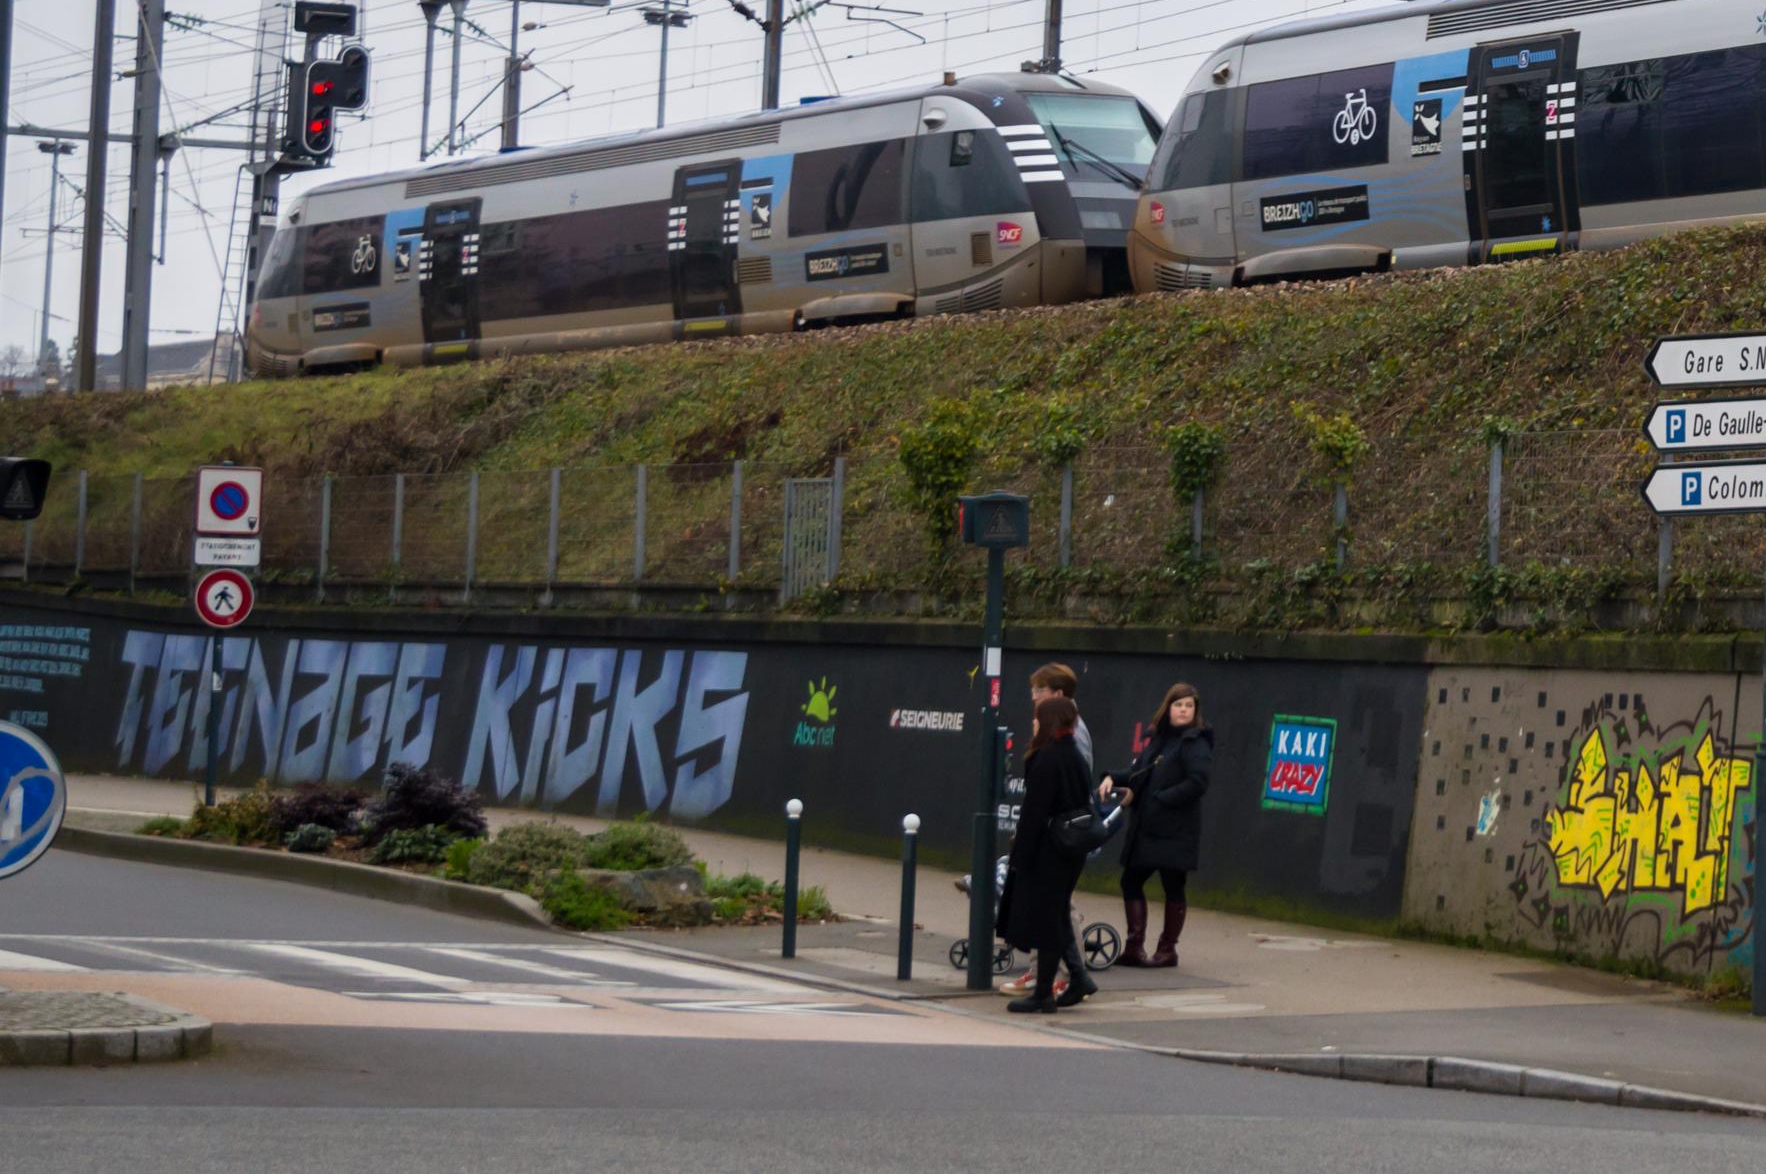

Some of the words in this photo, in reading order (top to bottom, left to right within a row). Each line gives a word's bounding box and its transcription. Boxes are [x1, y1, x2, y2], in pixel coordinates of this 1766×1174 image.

[1000, 228, 1022, 241] SNCF
[1684, 350, 1724, 374] Gare
[1693, 414, 1711, 437] De
[115, 629, 448, 785] TEENAGE
[462, 644, 750, 820] KICKS
[901, 710, 964, 730] SEIGNEURIE
[1278, 730, 1326, 757] KAKI
[1270, 758, 1324, 795] CRAZY
